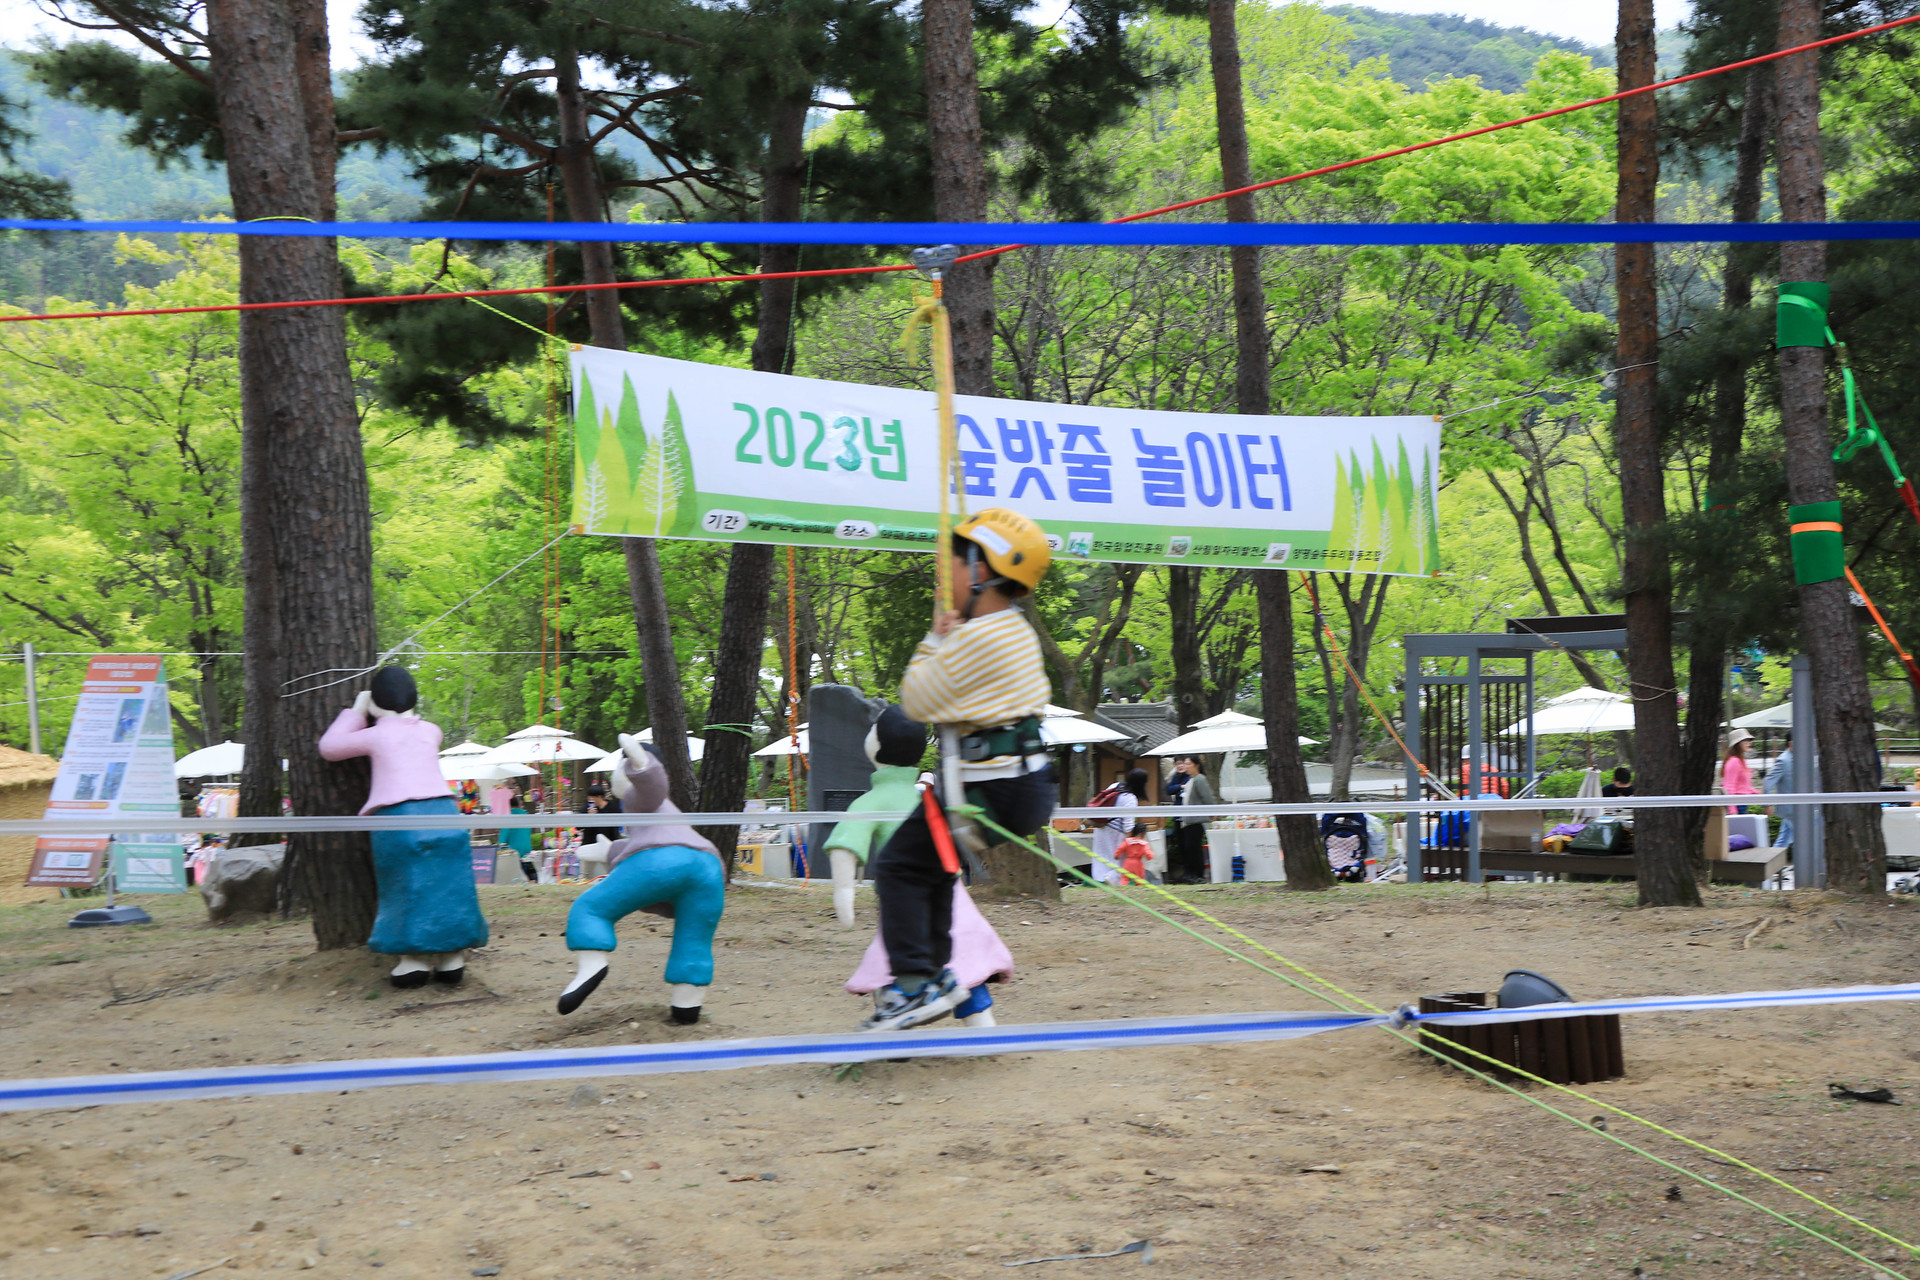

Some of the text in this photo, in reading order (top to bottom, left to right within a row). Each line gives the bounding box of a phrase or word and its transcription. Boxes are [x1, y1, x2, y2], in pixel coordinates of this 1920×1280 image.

[733, 402, 1293, 511] 2023년 숲밧줄 놀이터
[708, 514, 740, 530] 기간
[843, 525, 870, 537] 장소
